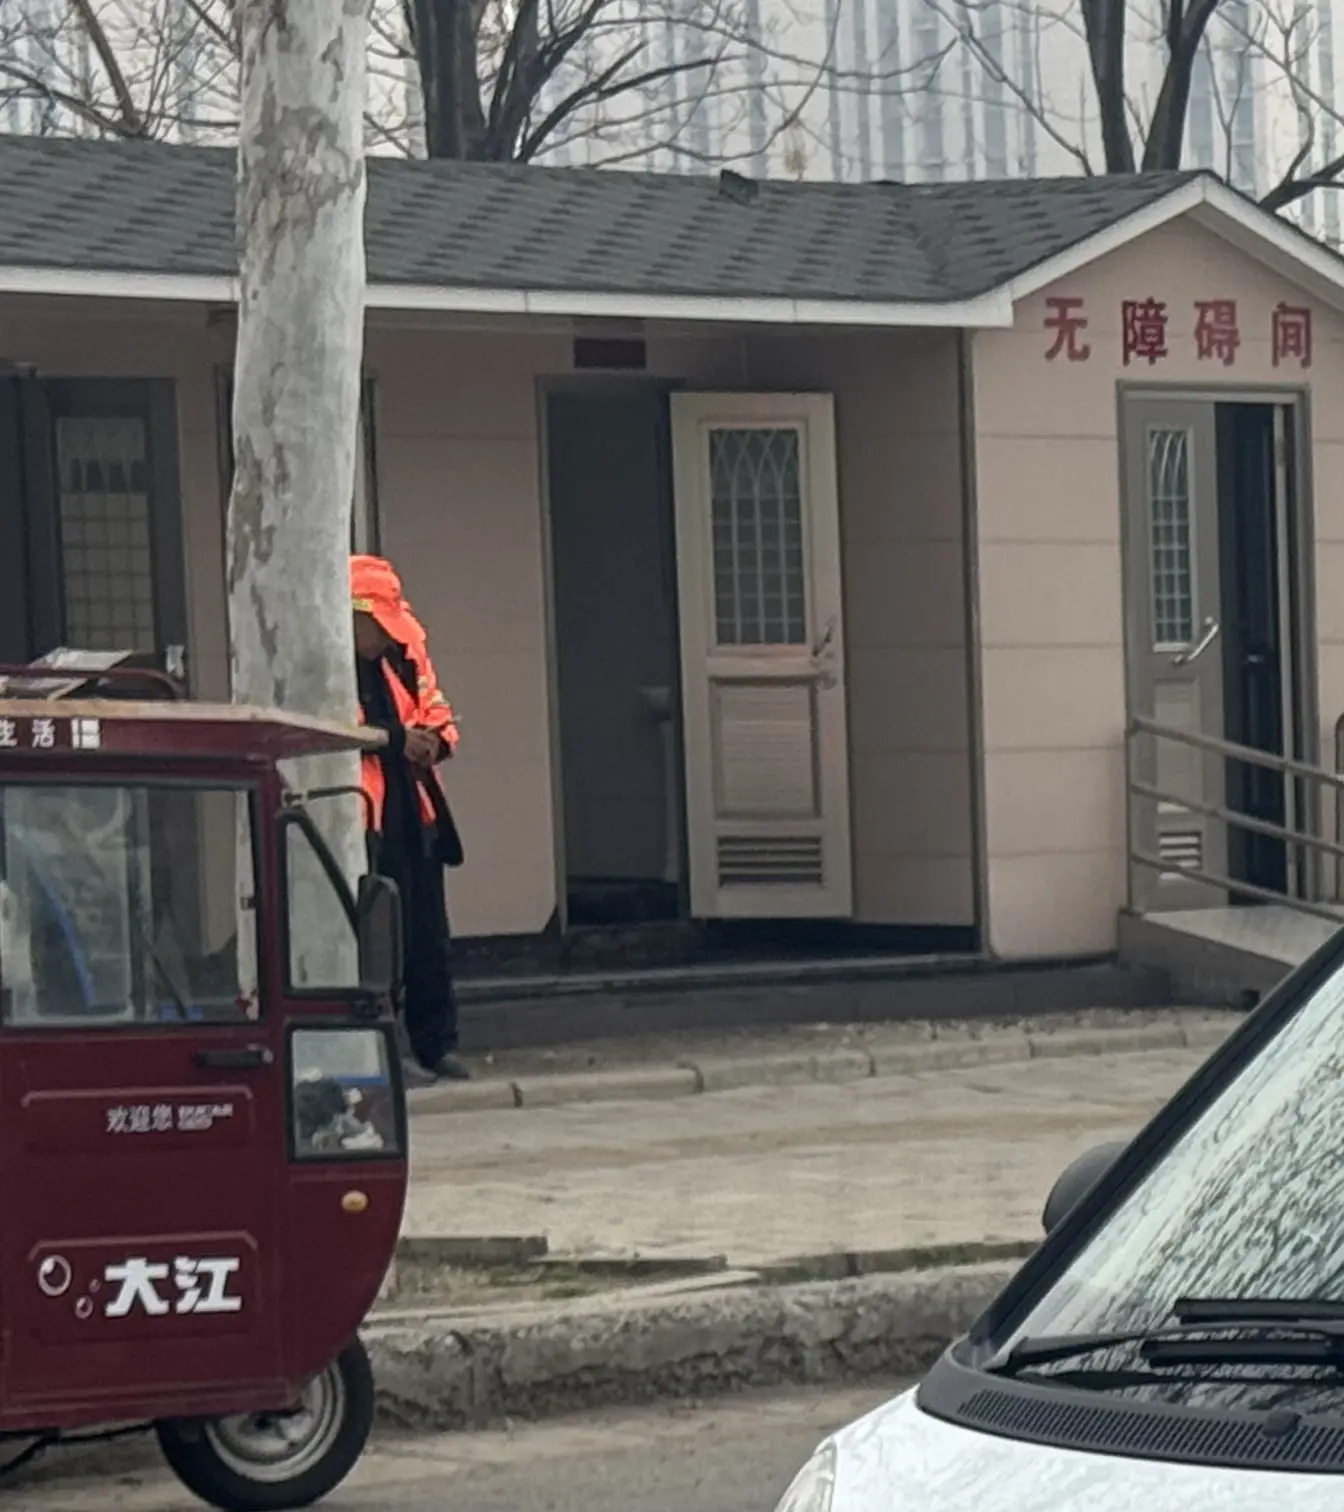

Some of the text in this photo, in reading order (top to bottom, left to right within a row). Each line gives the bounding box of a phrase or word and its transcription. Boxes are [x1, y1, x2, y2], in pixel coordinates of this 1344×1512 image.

[1043, 297, 1313, 368] 无障碍间
[104, 1256, 242, 1318] 大江
